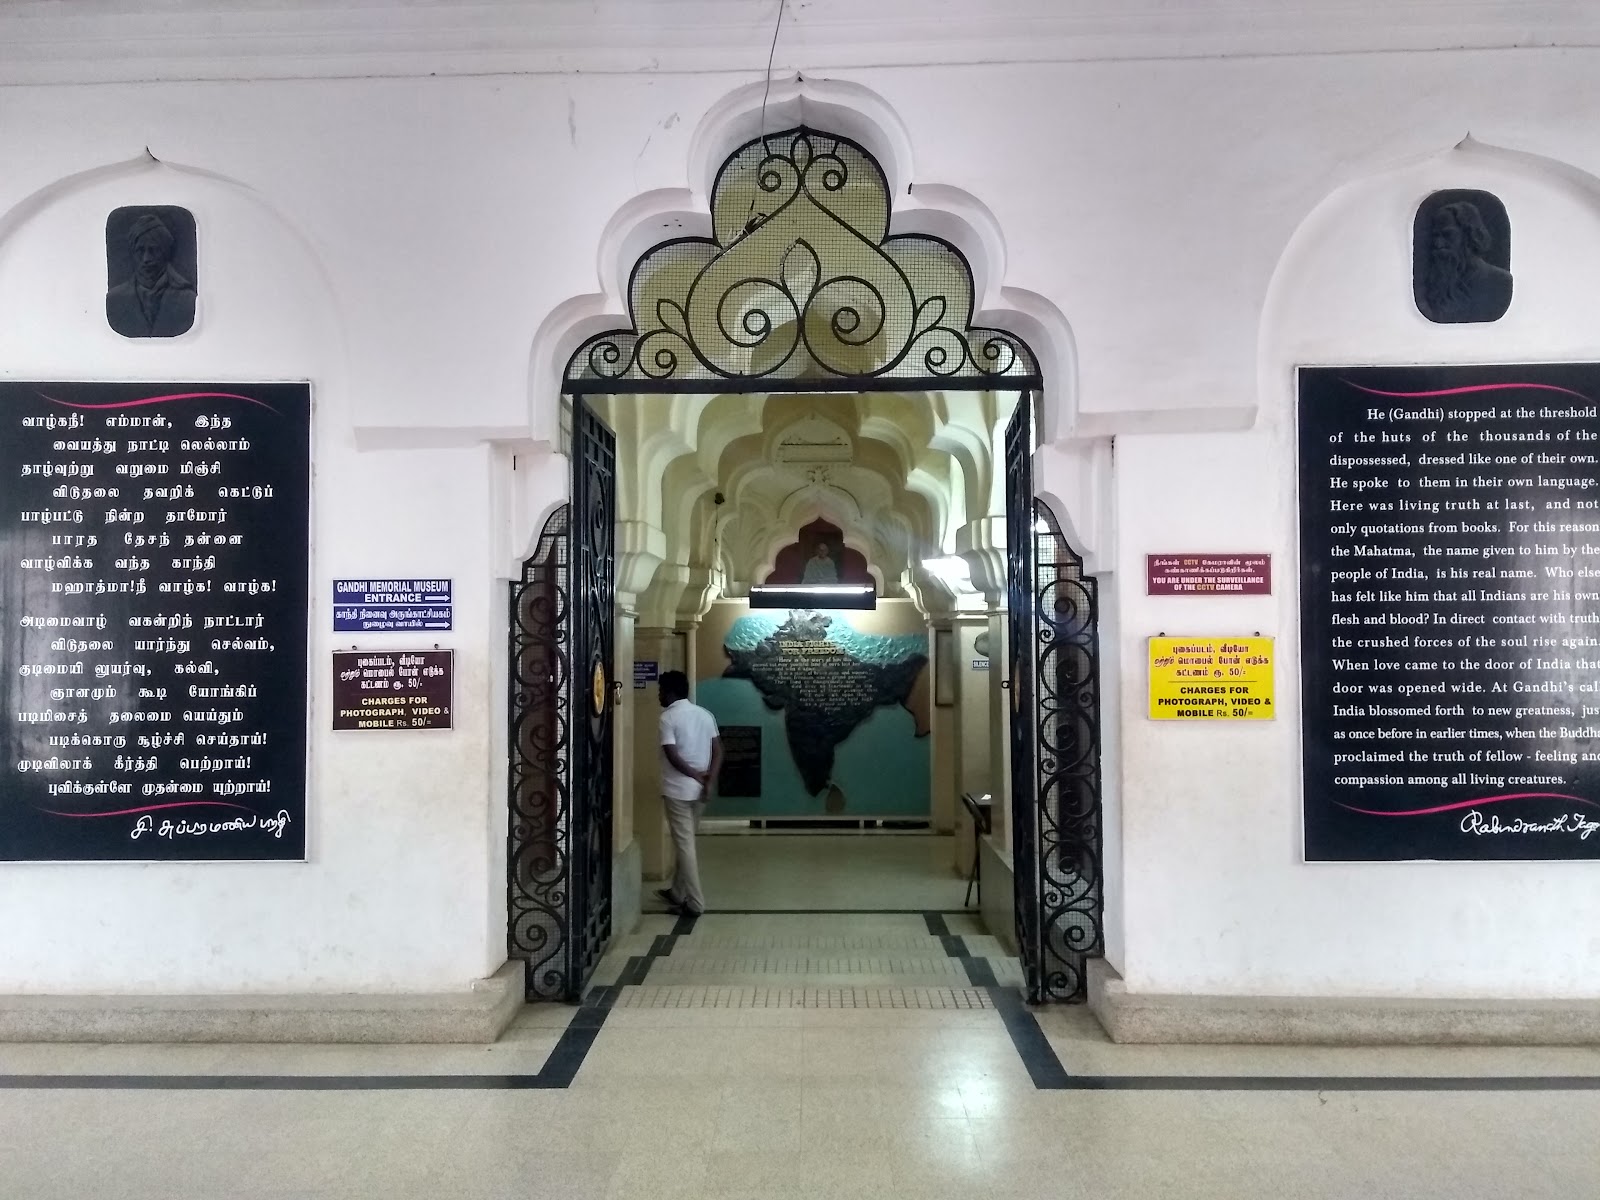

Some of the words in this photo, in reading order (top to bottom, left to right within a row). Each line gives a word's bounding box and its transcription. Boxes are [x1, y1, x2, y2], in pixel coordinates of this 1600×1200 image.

[22, 412, 84, 430] வாழ்கநீ!
[106, 414, 172, 428] எம்மான்,
[194, 414, 232, 430] இந்த
[1367, 408, 1385, 420] He
[1389, 408, 1444, 422] (Gandhi)
[1448, 407, 1496, 422] stopped
[1500, 409, 1512, 418] at
[1516, 406, 1536, 418] the
[1539, 406, 1597, 418] threshold
[53, 437, 116, 454] வையத்து
[127, 439, 170, 453] நாட்டி
[180, 437, 250, 450] லெல்லாம்
[21, 460, 94, 478] தாழ்வுற்று
[116, 464, 169, 478] வறுமை
[180, 460, 221, 477] மிஞ்சி
[1330, 454, 1410, 469] dispossessed,
[1418, 453, 1464, 464] dressed
[1469, 452, 1491, 464] like
[1495, 456, 1517, 464] one
[1520, 452, 1534, 464] of
[1537, 452, 1566, 464] their
[1570, 455, 1598, 463] own.
[1330, 500, 1363, 511] Here
[1368, 502, 1394, 510] was
[1399, 499, 1440, 514] living
[1445, 498, 1480, 510] truth
[1486, 500, 1499, 510] at
[1505, 498, 1534, 511] last,
[1546, 498, 1570, 509] and
[1577, 500, 1599, 509] not
[21, 508, 83, 524] பாழ்பட்டு
[104, 508, 144, 525] நின்ற
[165, 508, 228, 524] தாமோர்
[20, 555, 93, 572] வாழ்விக்க
[114, 555, 150, 572] வந்த
[171, 555, 216, 572] காந்தி
[1331, 568, 1372, 583] people
[1375, 568, 1388, 579] of
[1392, 568, 1428, 580] India,
[1436, 568, 1446, 578] is
[1450, 567, 1468, 578] his
[1472, 567, 1496, 578] real
[1500, 570, 1536, 578] name.
[1544, 566, 1574, 578] Who
[1578, 566, 1600, 578] else
[158, 578, 211, 596] வாழ்க!
[224, 578, 276, 596] வாழ்க!
[337, 582, 367, 592] GANDHI
[370, 582, 411, 592] MEMORIAL
[414, 582, 448, 592] MUSEUM
[365, 594, 421, 602] ENTRANCE
[19, 613, 107, 630] அடிமைவாழ்
[128, 613, 192, 630] வகன்றிந்
[204, 613, 264, 630] நாட்டார்
[51, 637, 114, 653] விடுதலை
[134, 637, 190, 654] யார்ந்து
[211, 636, 274, 652] செல்வம்,
[1332, 636, 1352, 648] the
[1357, 636, 1409, 648] crushed
[1414, 636, 1453, 647] forces
[1458, 636, 1472, 647] of
[1476, 636, 1496, 647] the
[1501, 635, 1528, 646] soul
[1533, 636, 1557, 646] rise
[1562, 636, 1600, 650] again.
[362, 697, 406, 705] CHARGES
[18, 708, 88, 724] படிமிசைத்
[109, 712, 172, 724] தலைமை
[183, 708, 244, 725] யெய்தும்
[340, 708, 406, 717] PHOTOGRAPH,
[412, 707, 440, 715] VIDEO
[48, 780, 132, 796] புவிக்குள்ளே
[142, 780, 204, 796] முதன்மை
[213, 779, 270, 796] யுற்றாய்!
[1334, 774, 1404, 788] compassion
[1408, 776, 1448, 788] among
[1451, 773, 1467, 784] all
[1470, 773, 1505, 788] living
[1508, 775, 1566, 784] creatures.
[1461, 810, 1568, 835] Rabindranath
